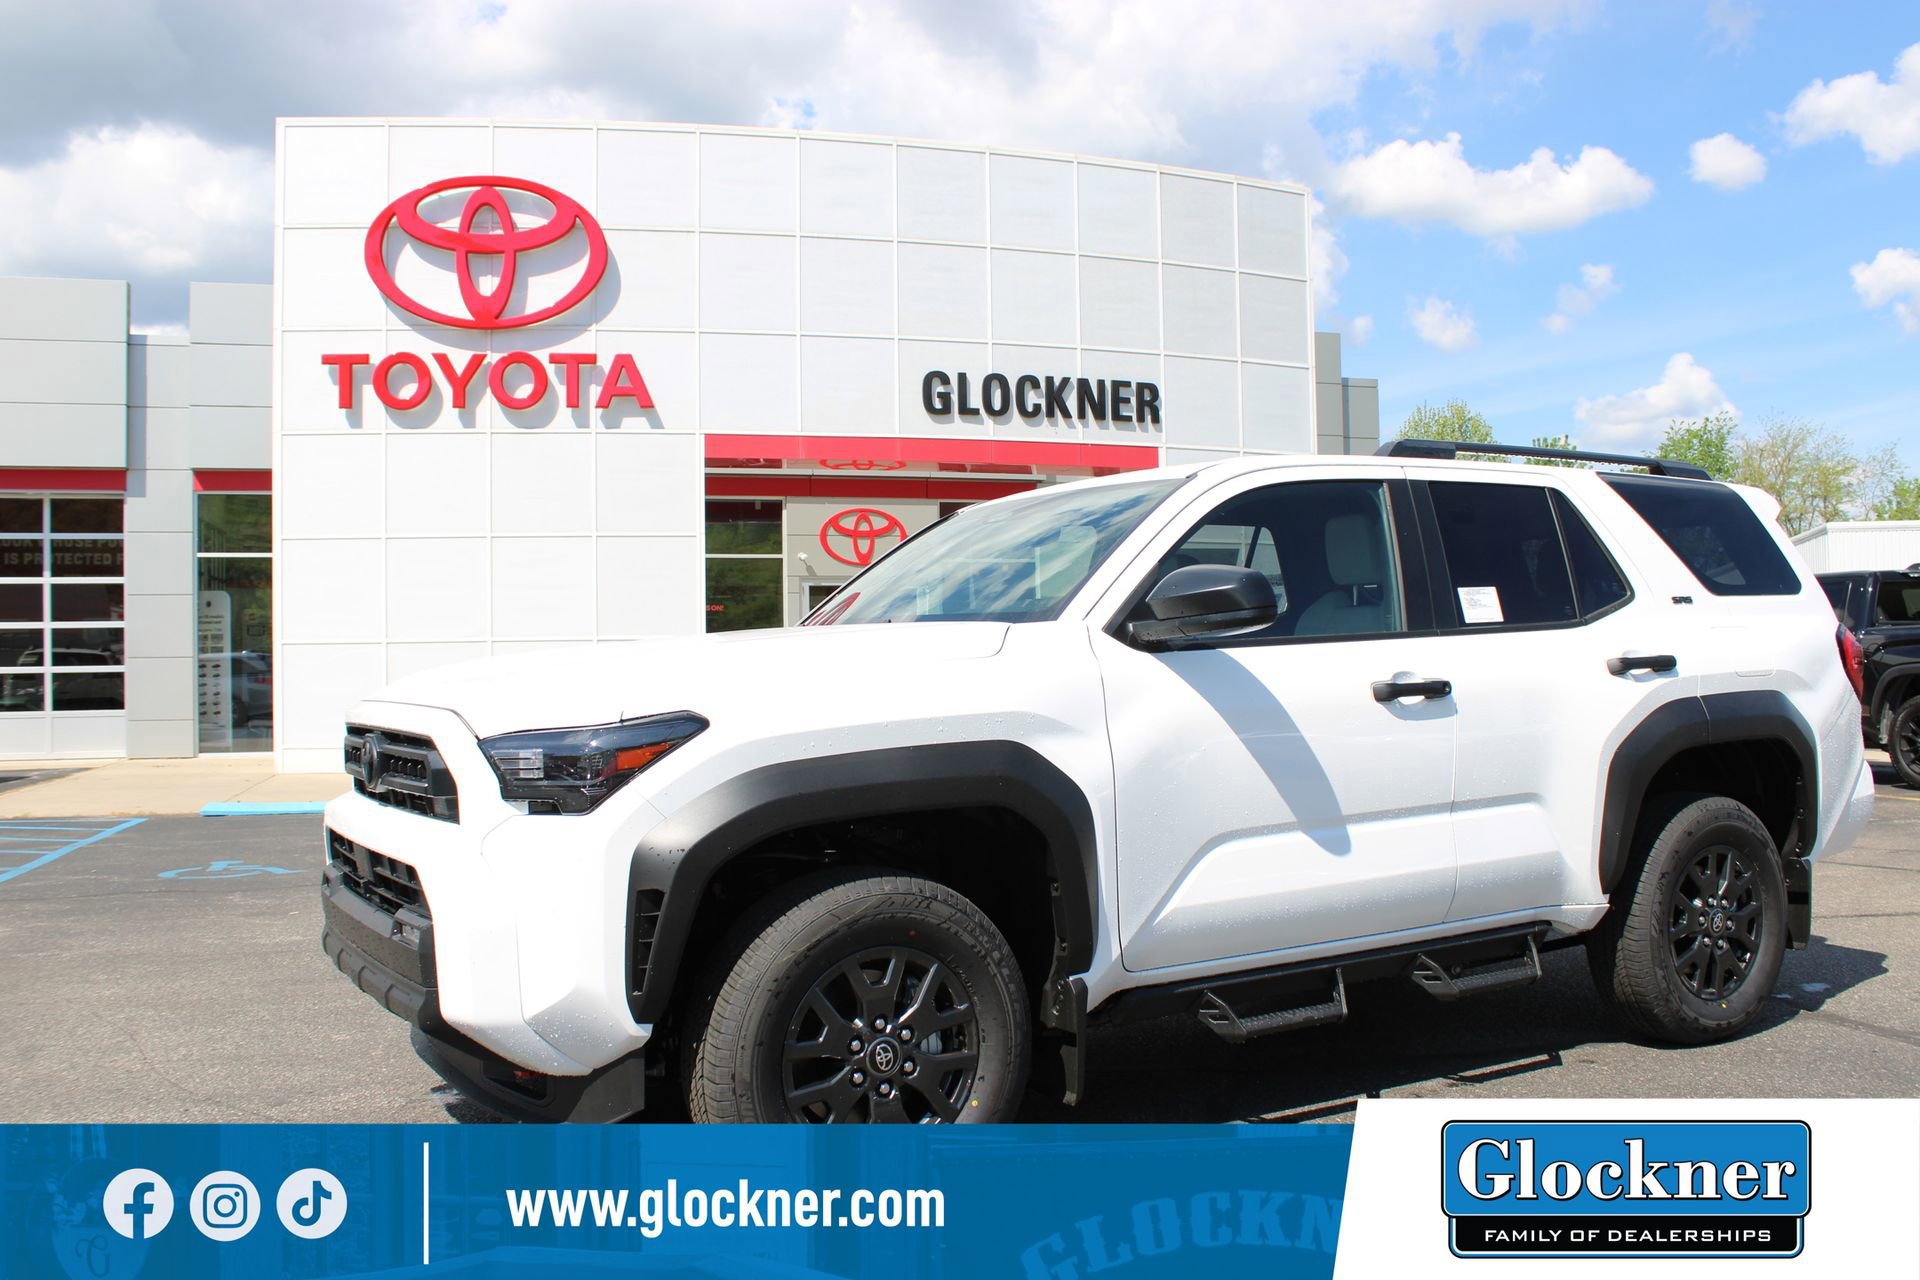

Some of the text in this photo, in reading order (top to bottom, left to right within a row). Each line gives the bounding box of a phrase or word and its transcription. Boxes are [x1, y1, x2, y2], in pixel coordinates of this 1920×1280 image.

[321, 351, 655, 411] TOYOTA
[922, 370, 1160, 424] GLOCKNER
[23, 553, 111, 564] PRTECTED
